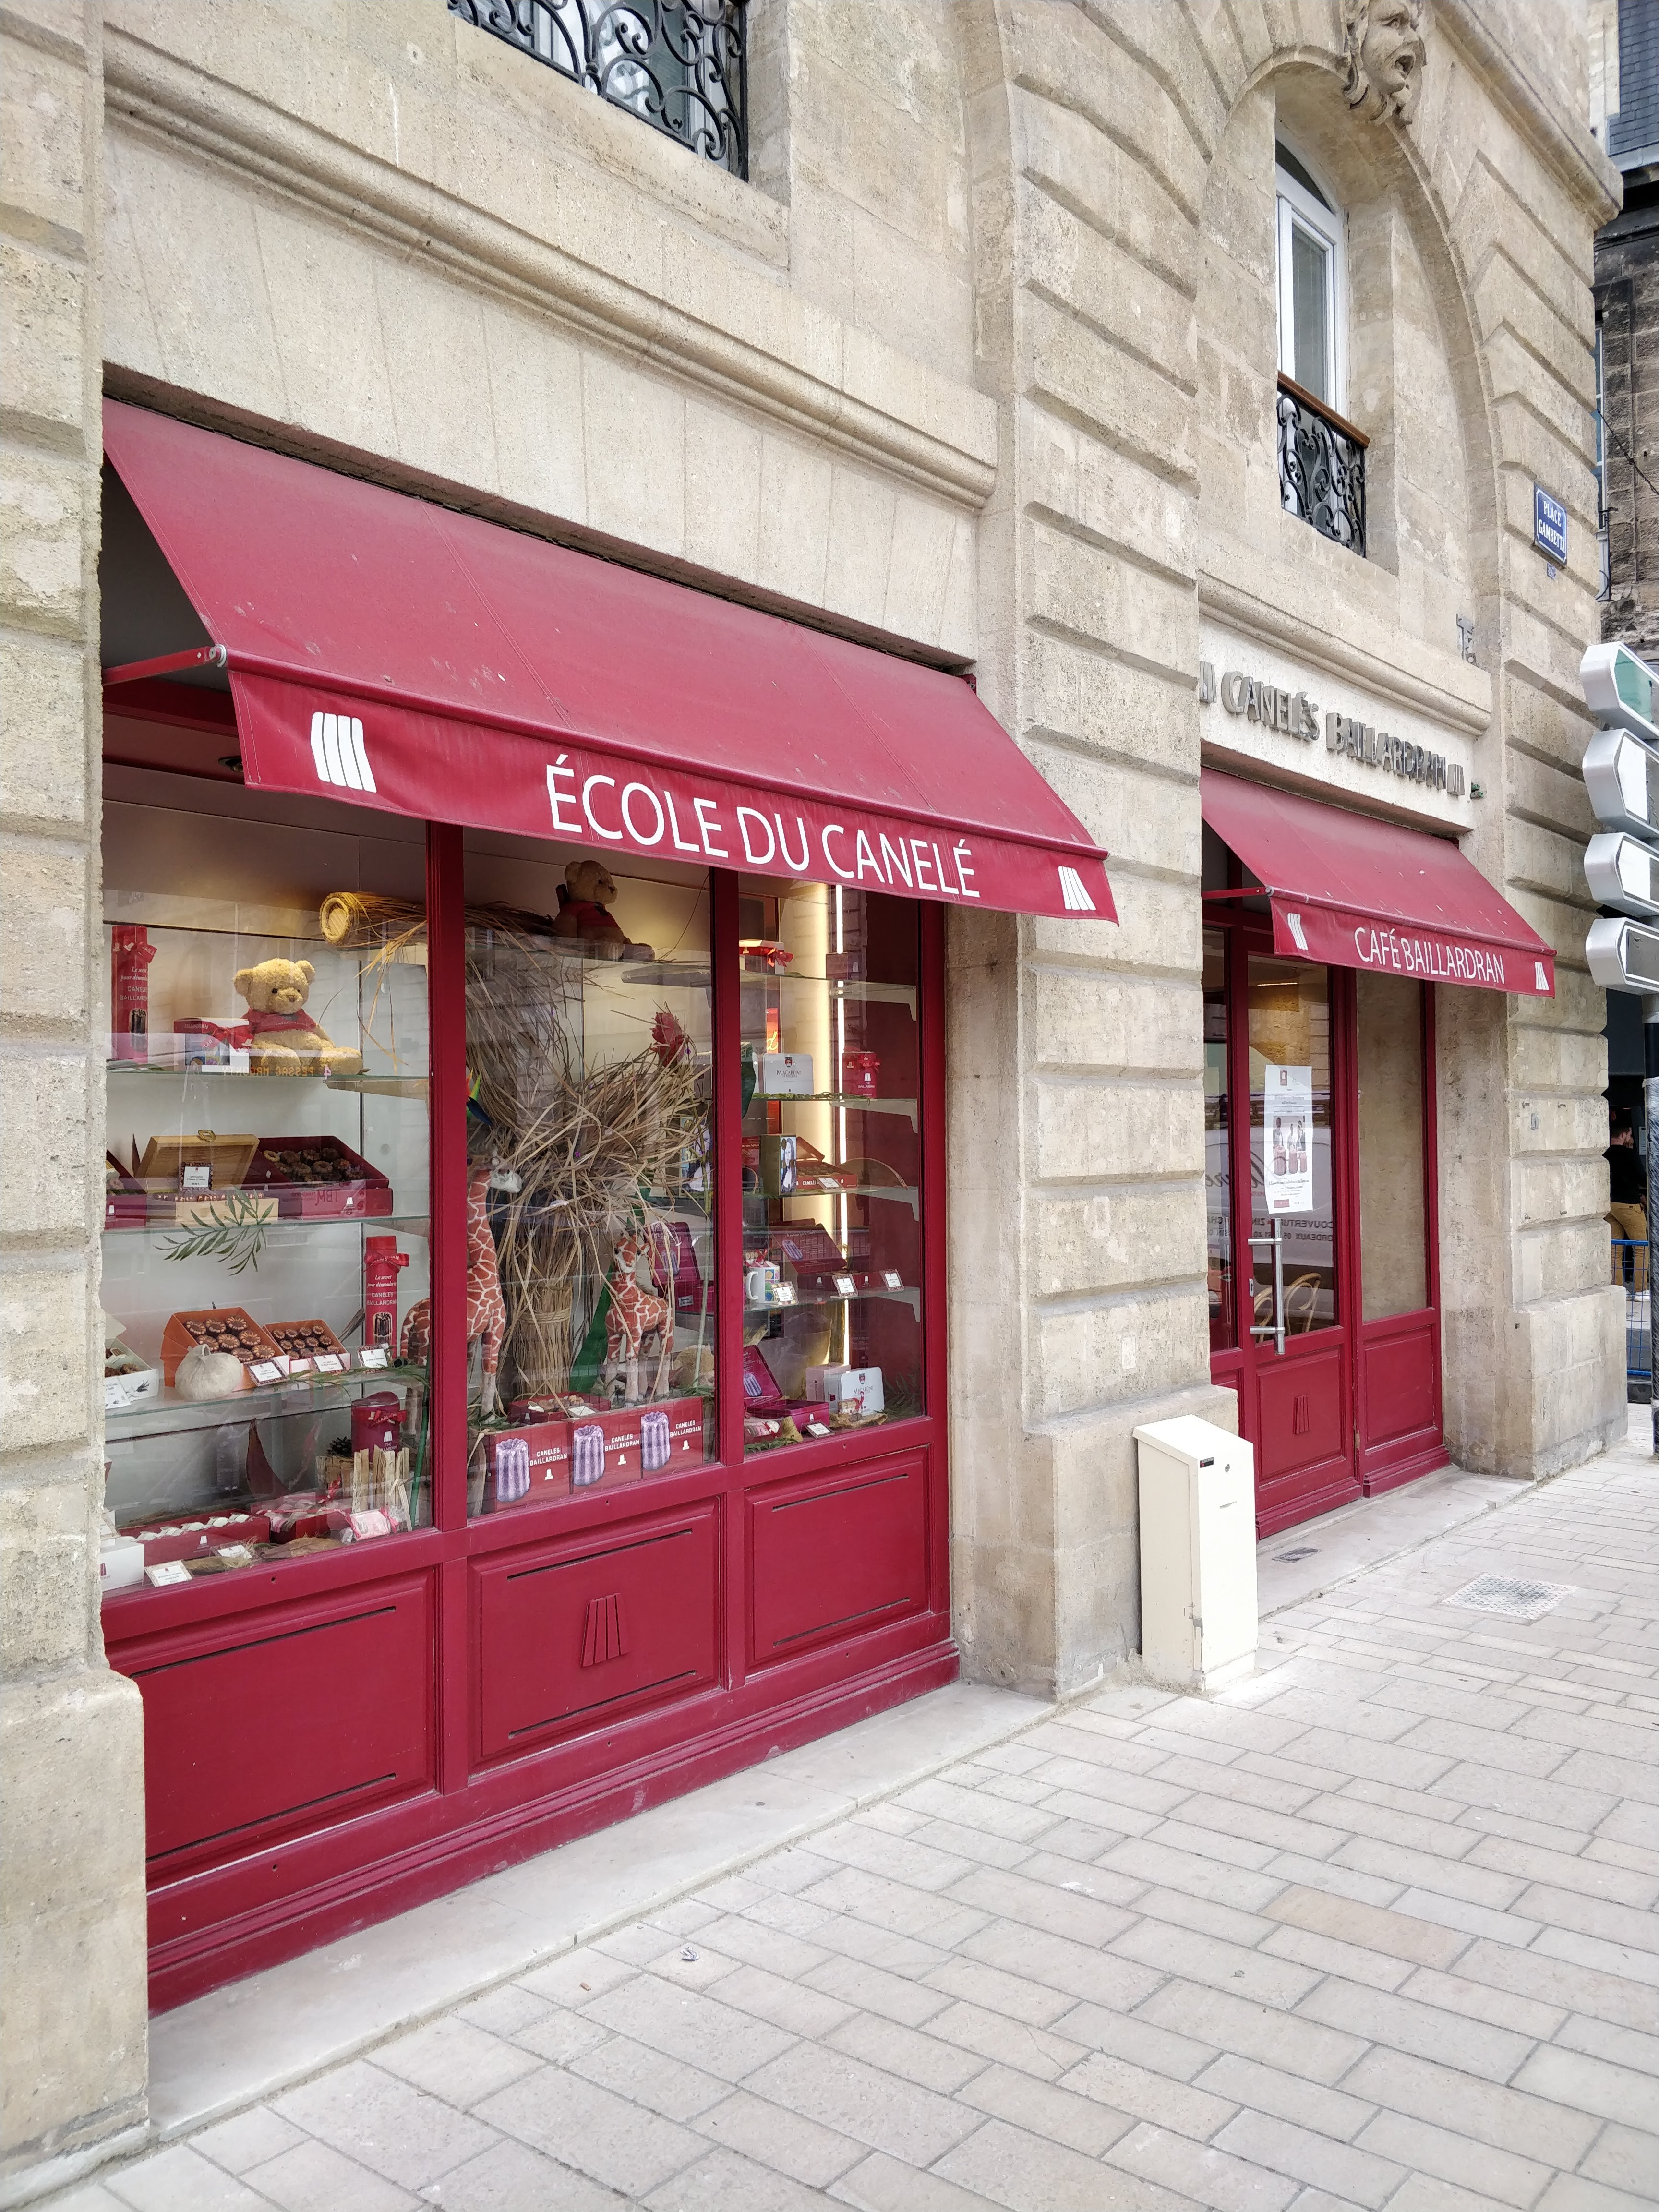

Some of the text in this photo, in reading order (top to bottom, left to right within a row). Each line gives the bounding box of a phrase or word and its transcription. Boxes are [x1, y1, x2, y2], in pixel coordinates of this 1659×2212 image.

[1543, 500, 1562, 528] PLACE
[1539, 519, 1566, 553] GAMBETTA
[1221, 671, 1446, 790] CANELÉS BAILLARDRAN
[546, 753, 980, 898] ÉCOLE DU CANELÉ
[1354, 927, 1505, 984] CAFÉ BAILLARDRAN
[669, 1426, 701, 1438] BAILLARDRAN
[675, 1420, 696, 1430] CANELÉS
[611, 1433, 633, 1443] CANELÉS
[537, 1447, 560, 1457] CANELÉS
[605, 1439, 640, 1452] BAILLARDRAN
[529, 1453, 567, 1467] BAILLARDRAN
